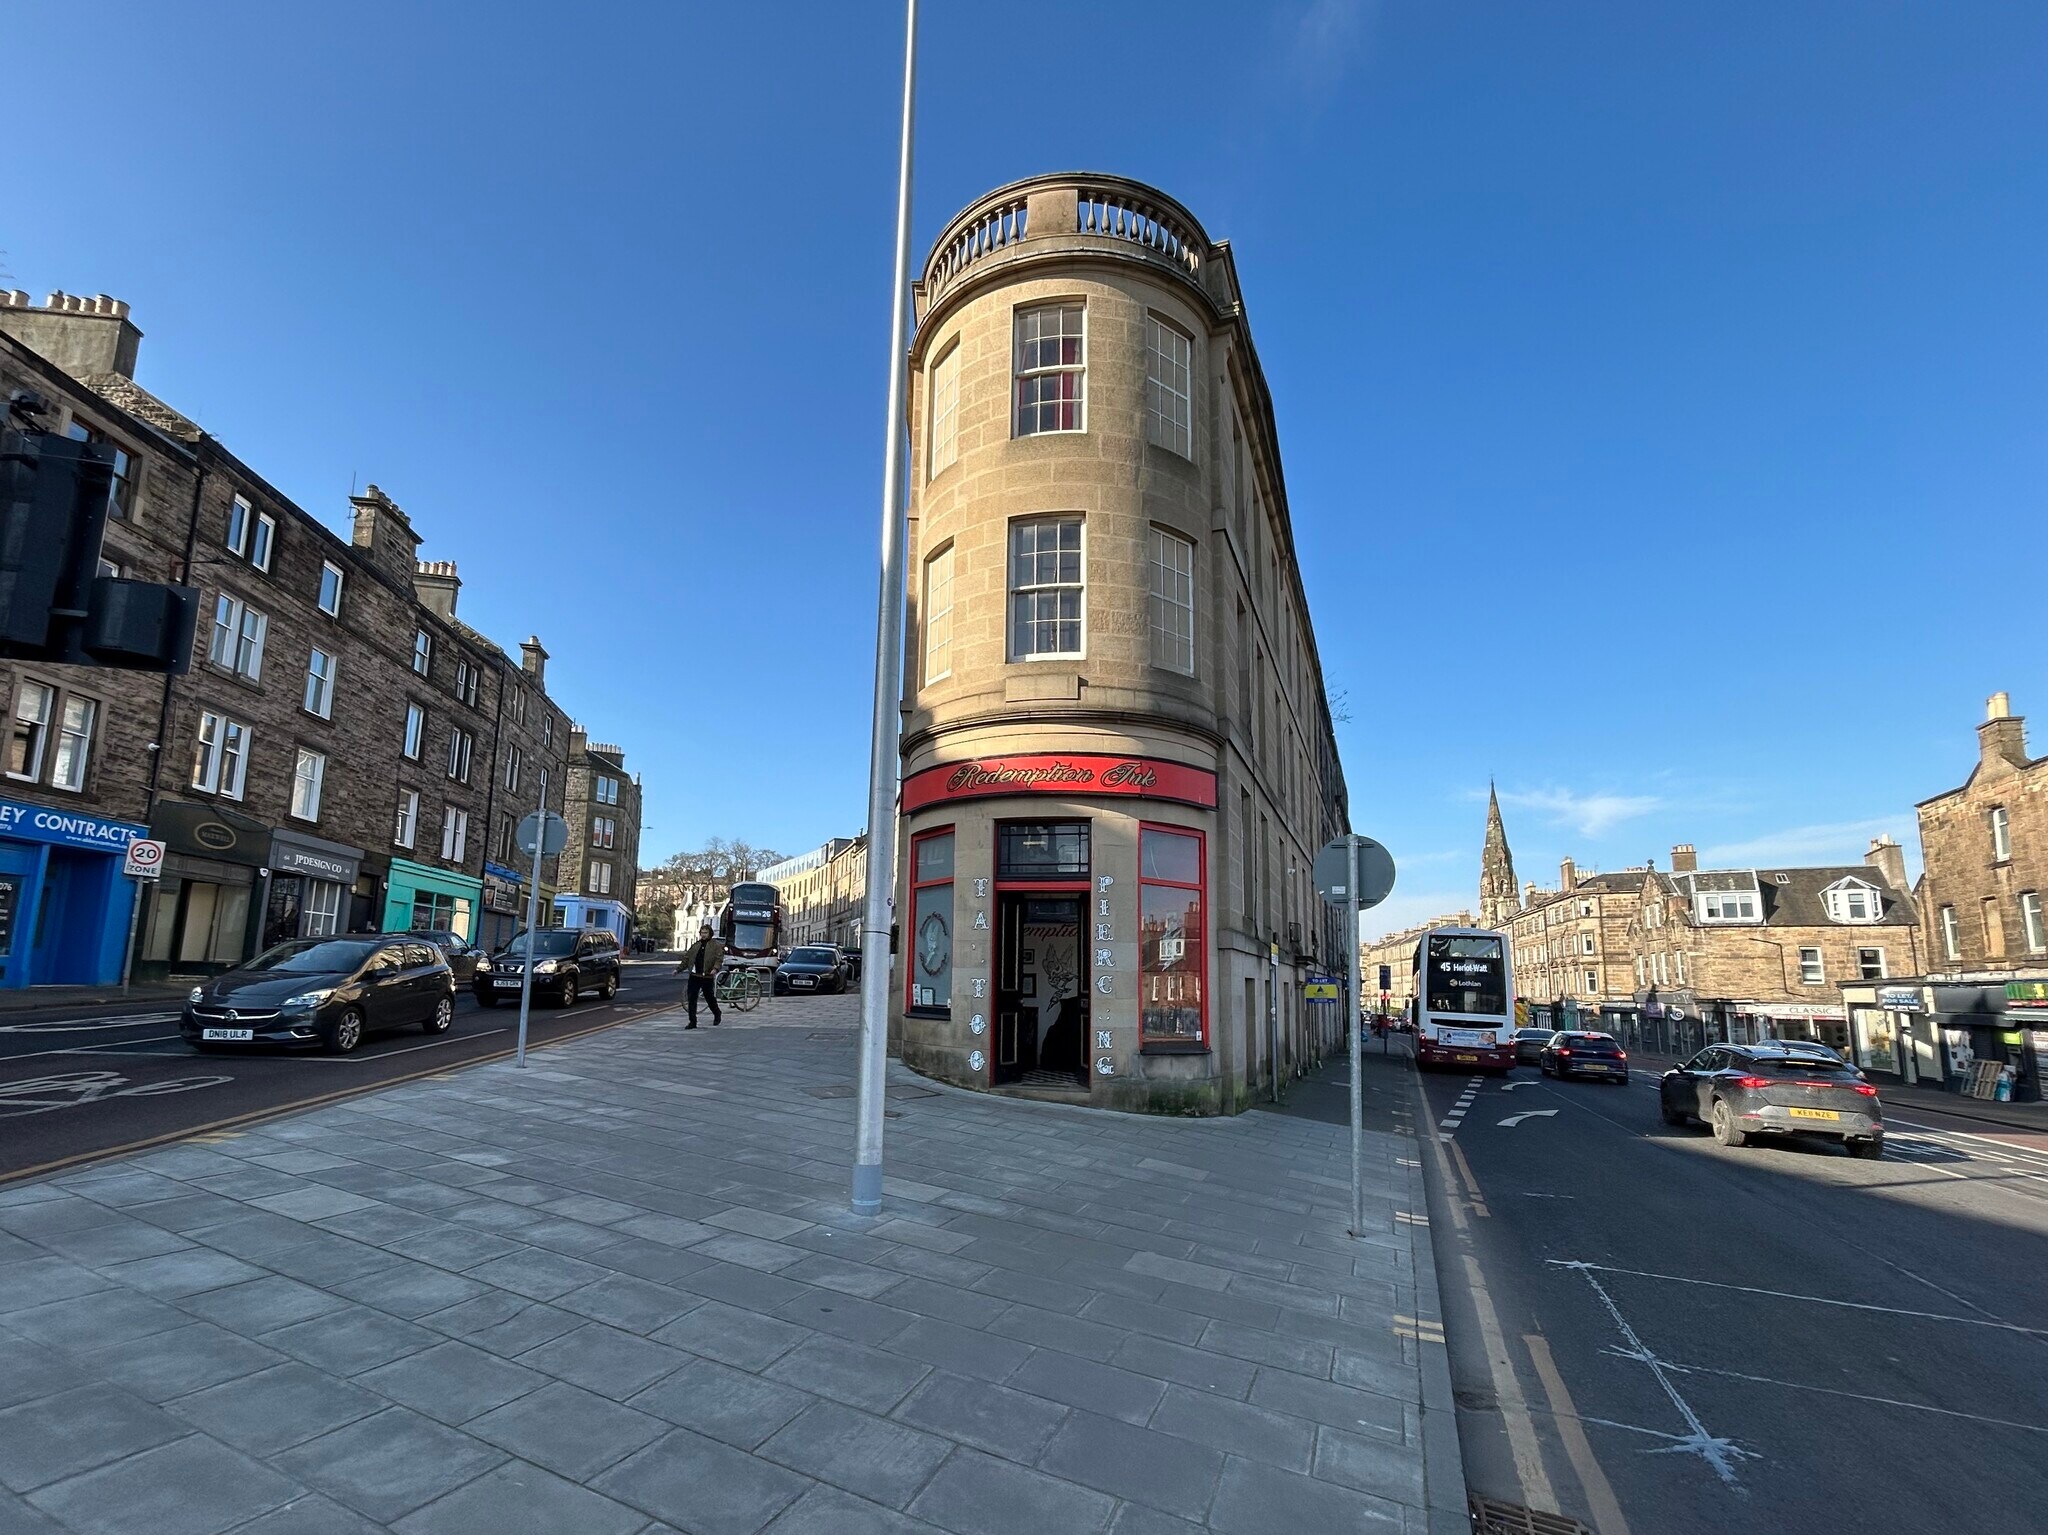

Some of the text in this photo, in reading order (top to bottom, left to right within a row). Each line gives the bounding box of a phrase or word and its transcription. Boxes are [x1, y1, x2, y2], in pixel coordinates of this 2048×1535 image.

[947, 761, 1157, 791] Redemption Ink
[34, 813, 138, 842] CONTRACTS
[135, 847, 157, 859] 20
[129, 864, 158, 875] ZONE
[1440, 962, 1488, 972] 45 Heriot-Watt
[968, 878, 990, 1071] TATOO
[1095, 875, 1116, 1075] PIERCNG
[1789, 1007, 1833, 1015] CLASSIC
[208, 1030, 248, 1039] DN18 ULR
